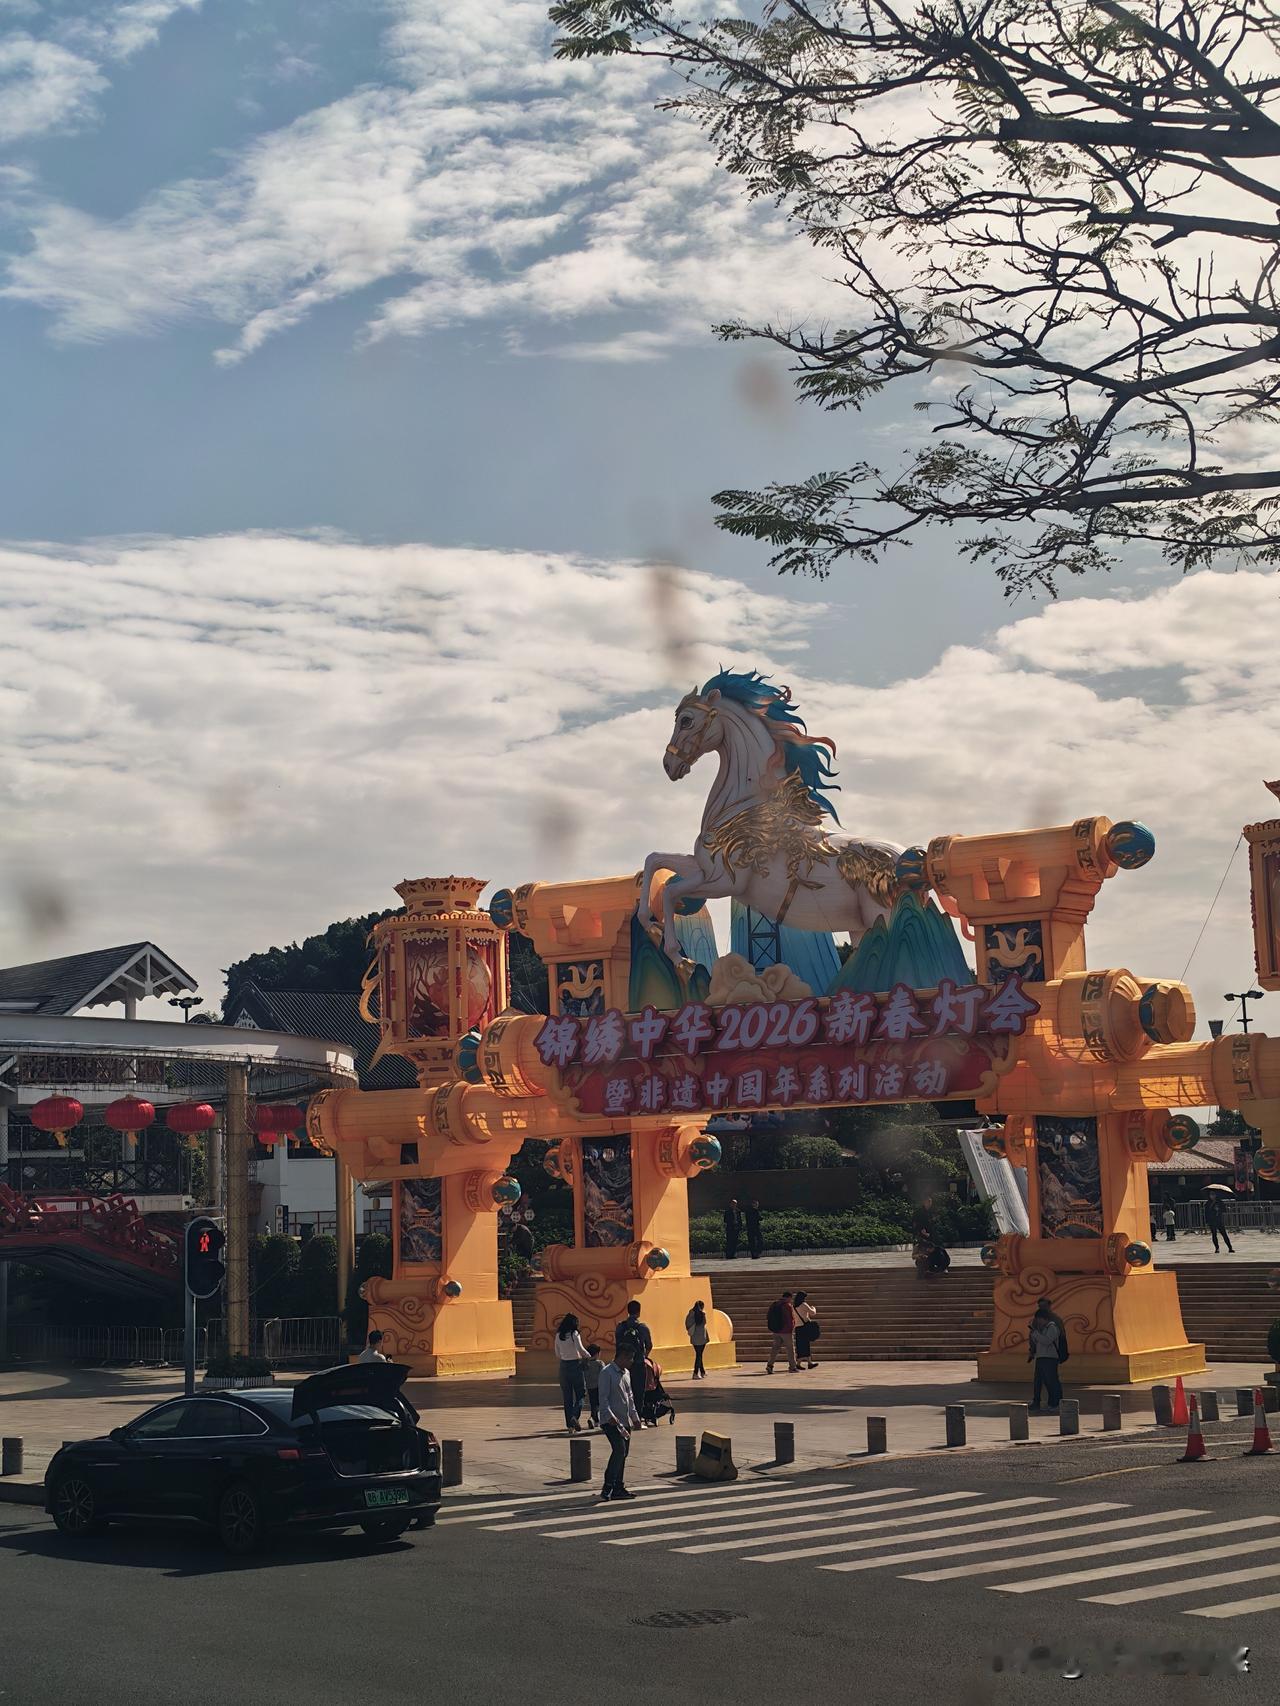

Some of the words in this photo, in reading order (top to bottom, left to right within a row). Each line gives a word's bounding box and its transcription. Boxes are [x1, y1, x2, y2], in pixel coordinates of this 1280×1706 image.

[537, 978, 1036, 1066] 锦绣中华2026新春灯会
[604, 1060, 947, 1113] 暨非遗中国年系列活动
